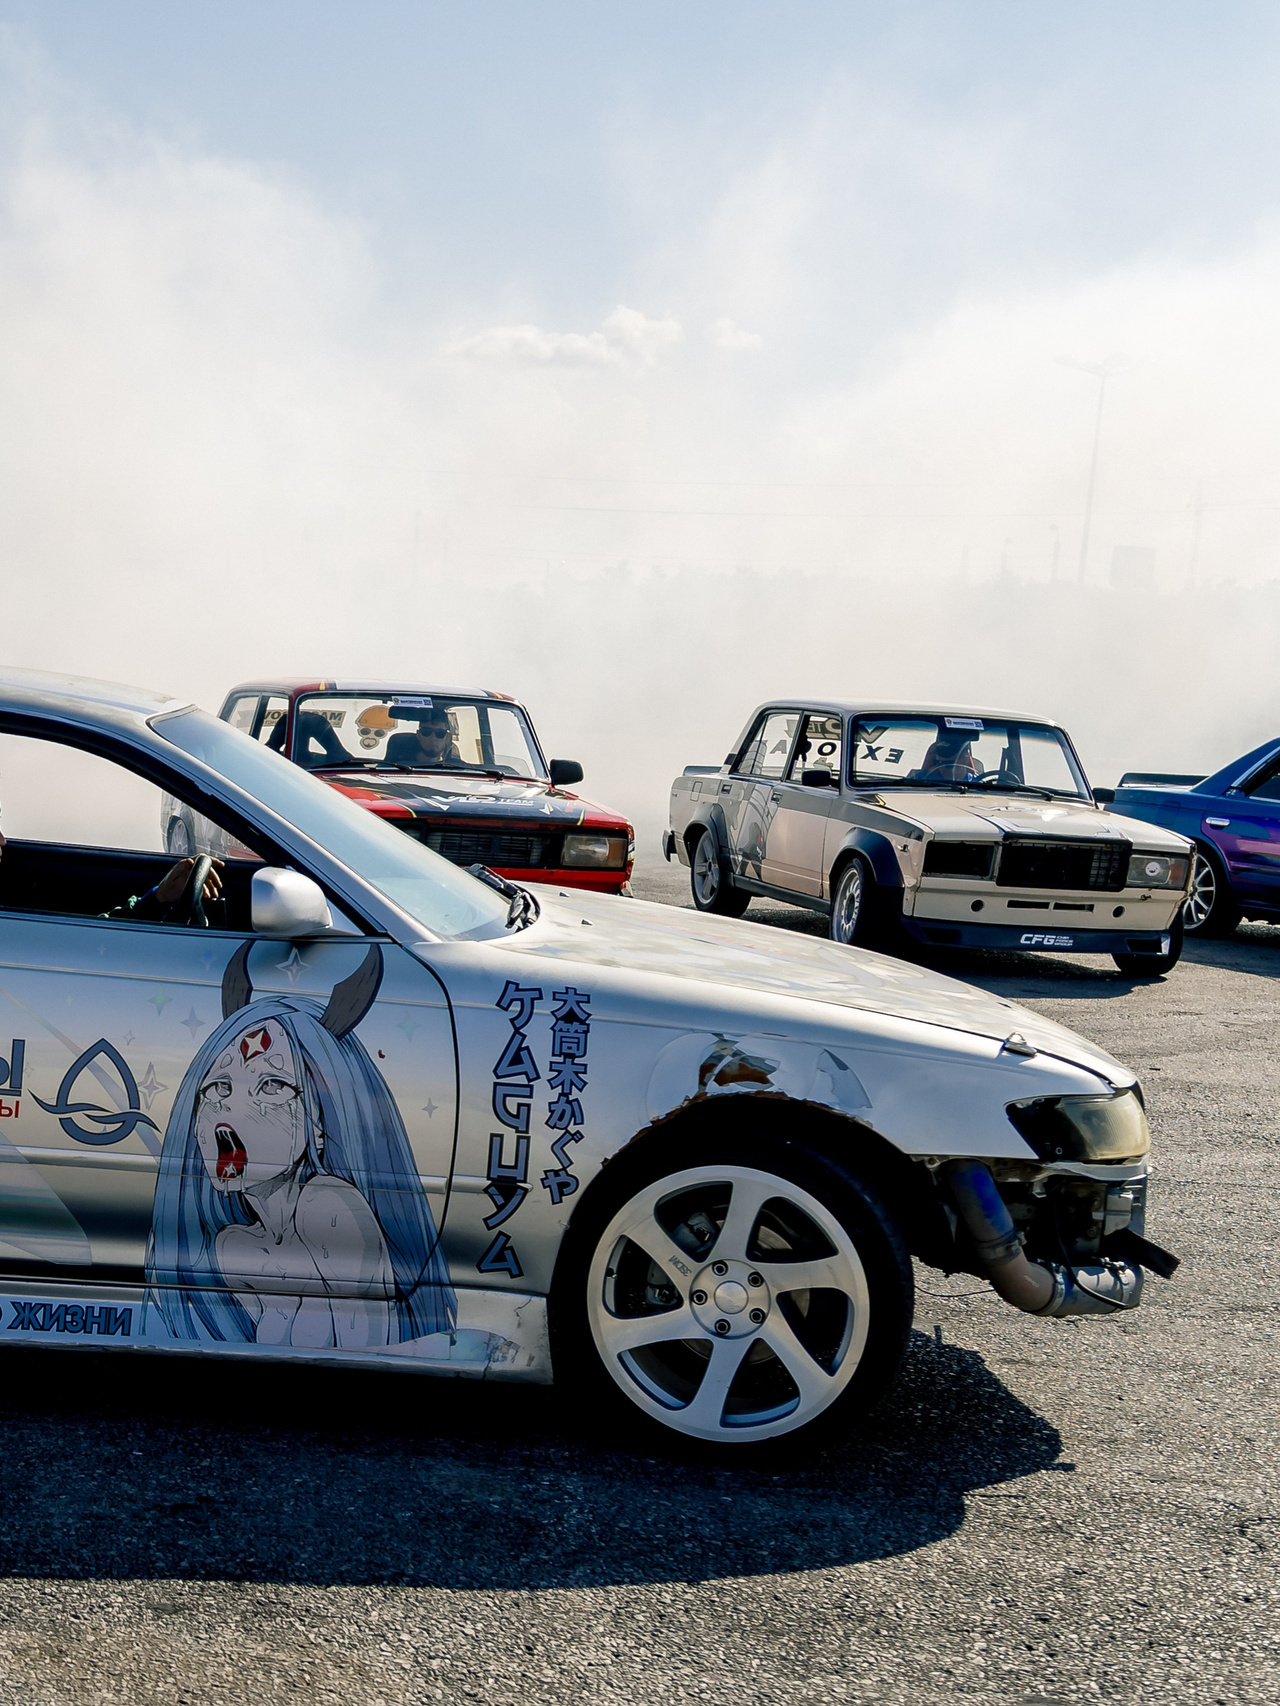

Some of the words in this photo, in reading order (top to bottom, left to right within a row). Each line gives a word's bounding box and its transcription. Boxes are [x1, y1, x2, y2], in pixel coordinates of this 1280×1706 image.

[1020, 934, 1056, 945] CFG
[540, 986, 593, 1206] 大筒木かぐや
[6, 1300, 133, 1337] ЖИЗНИ
